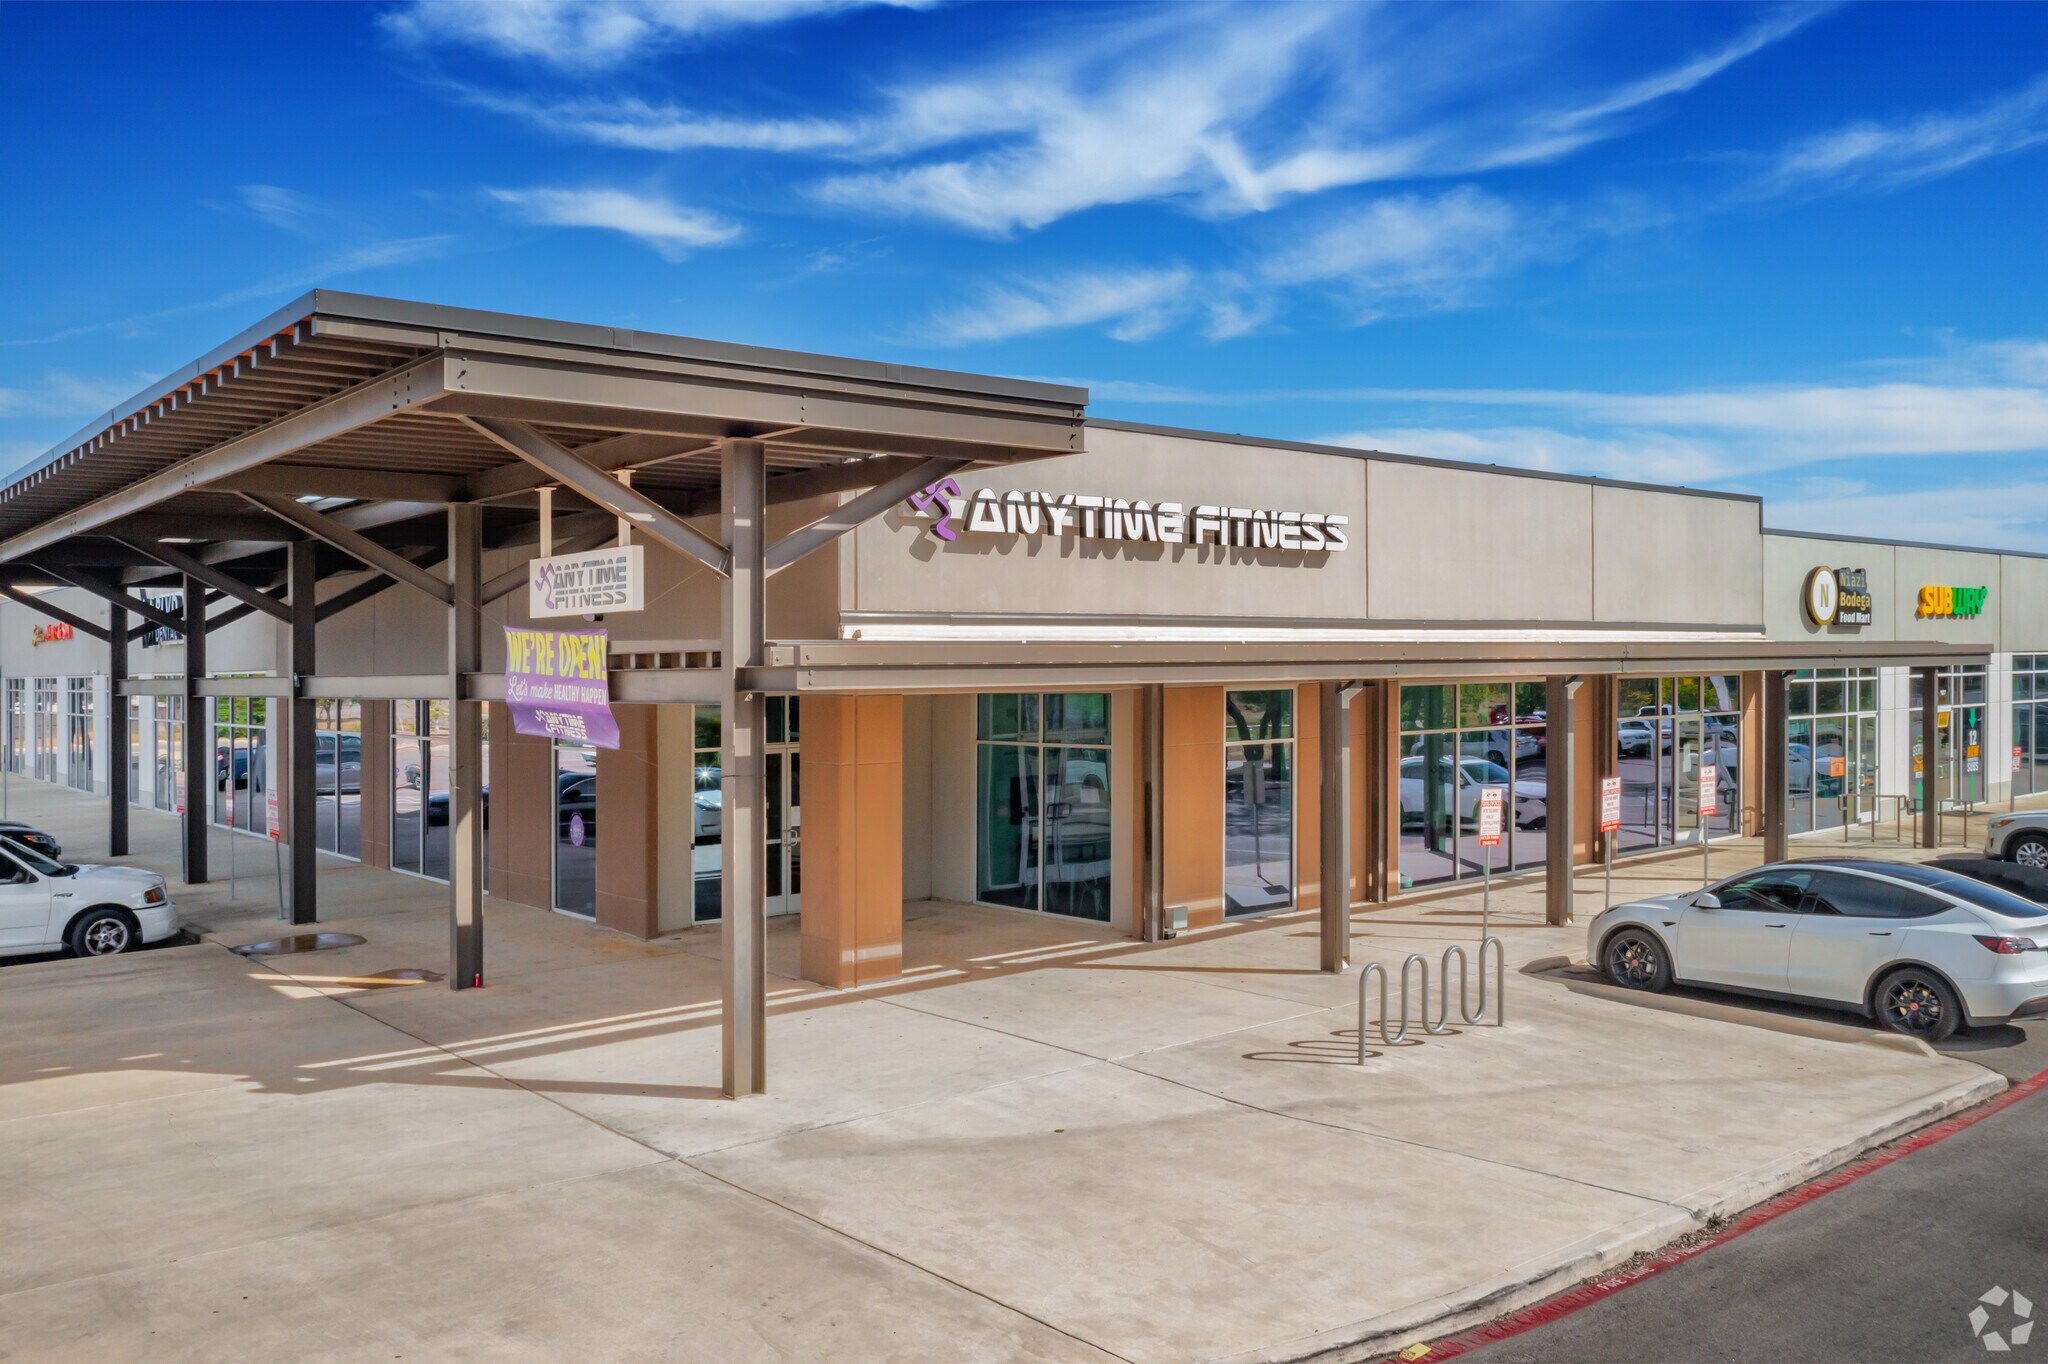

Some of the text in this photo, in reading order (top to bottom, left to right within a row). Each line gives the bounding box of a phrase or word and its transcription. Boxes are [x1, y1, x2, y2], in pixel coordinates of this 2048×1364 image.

[964, 487, 1350, 552] ANYTIME FITNESS
[553, 556, 627, 590] ANYTIME
[555, 583, 627, 610] FITNESS
[1820, 583, 1829, 608] N
[1840, 592, 1871, 611] Bodega
[1920, 585, 1989, 618] SUBWAY
[1840, 611, 1871, 624] Food Mart
[506, 631, 608, 680] WE'RE OPEN!
[507, 675, 607, 705] Let's make HEALTHY HAPPEN
[545, 711, 586, 729] ANYTIME
[549, 723, 588, 740] FITNESS
